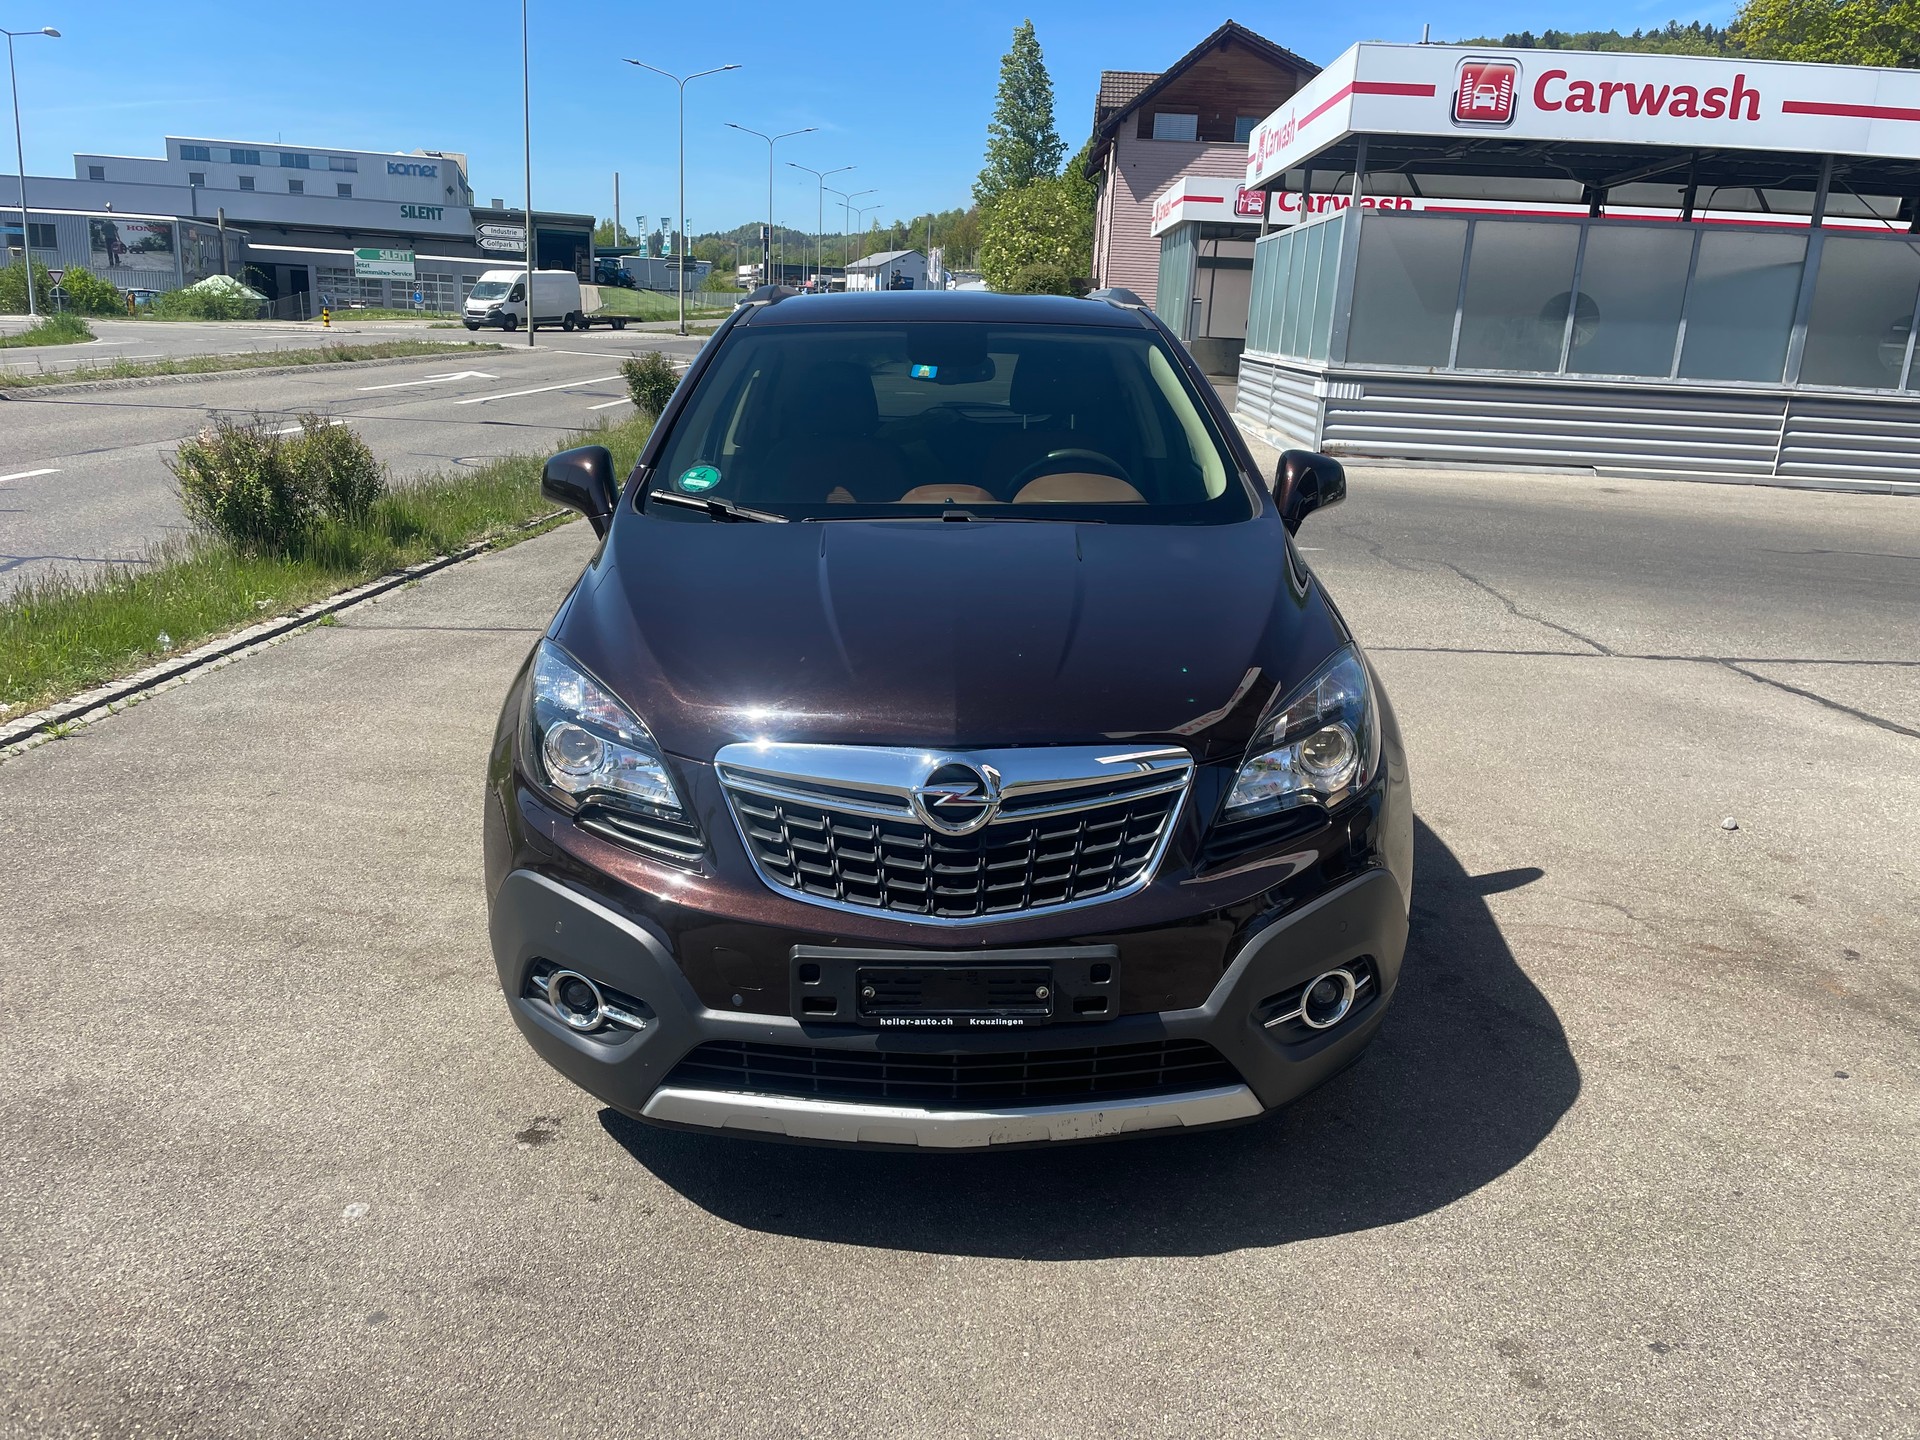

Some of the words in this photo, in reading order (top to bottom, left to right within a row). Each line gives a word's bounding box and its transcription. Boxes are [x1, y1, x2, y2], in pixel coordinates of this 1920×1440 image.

[1533, 69, 1761, 121] Carwash
[400, 205, 443, 220] SILENT
[126, 225, 168, 233] HONDA
[490, 227, 518, 236] Industrie
[486, 240, 513, 249] Golfpark
[379, 250, 412, 261] SILENT
[880, 1018, 954, 1026] heller-auto.ch
[969, 1018, 1024, 1026] Kreuzlingen
